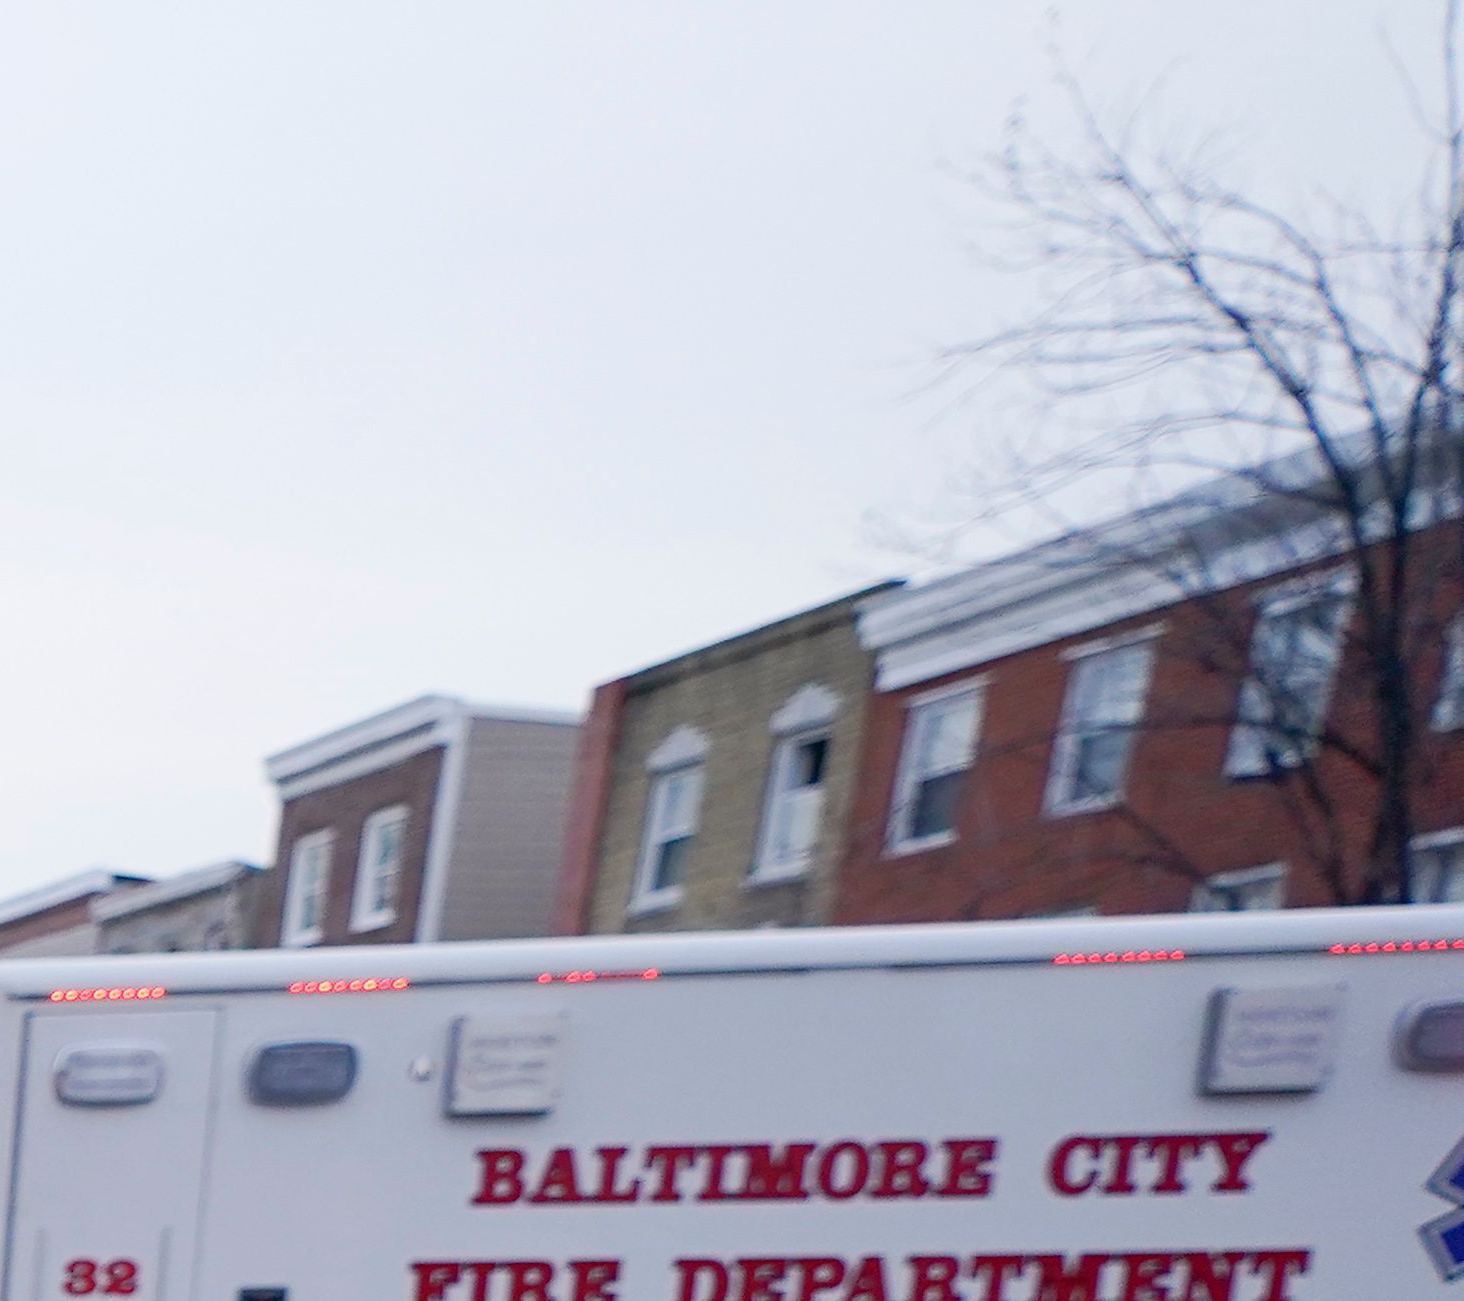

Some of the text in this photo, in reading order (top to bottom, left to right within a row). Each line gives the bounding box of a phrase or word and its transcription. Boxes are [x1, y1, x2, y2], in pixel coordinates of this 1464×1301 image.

[470, 1129, 1273, 1204] BALTIMORE CITY
[65, 1260, 137, 1295] 32
